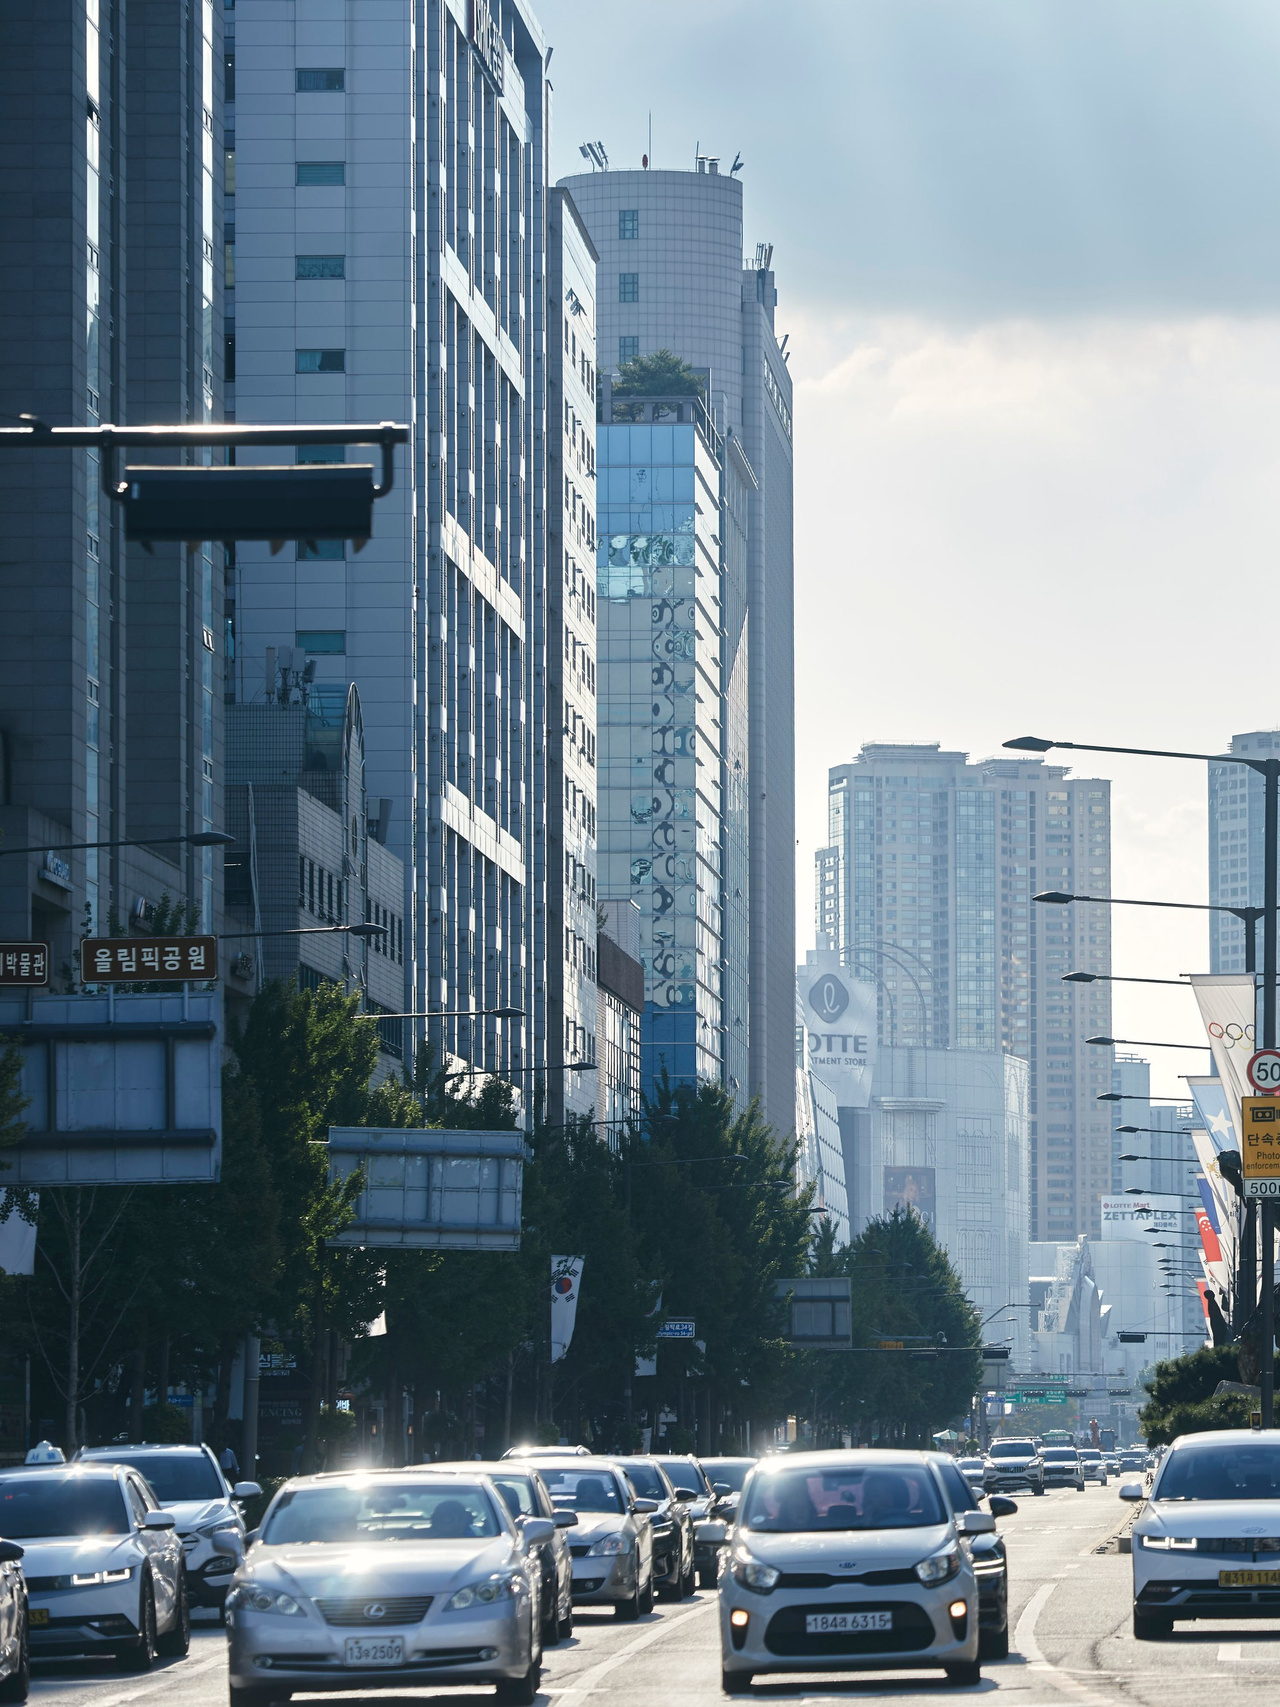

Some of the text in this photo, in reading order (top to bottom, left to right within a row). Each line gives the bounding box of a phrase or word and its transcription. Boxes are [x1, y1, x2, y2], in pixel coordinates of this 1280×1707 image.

[94, 945, 206, 973] 올림픽공원
[0, 952, 44, 977] 박물관
[844, 1057, 867, 1066] STORE
[1256, 1151, 1280, 1160] Photo
[1103, 1211, 1178, 1220] ZETTAPLEX
[259, 1408, 302, 1417] ENCING
